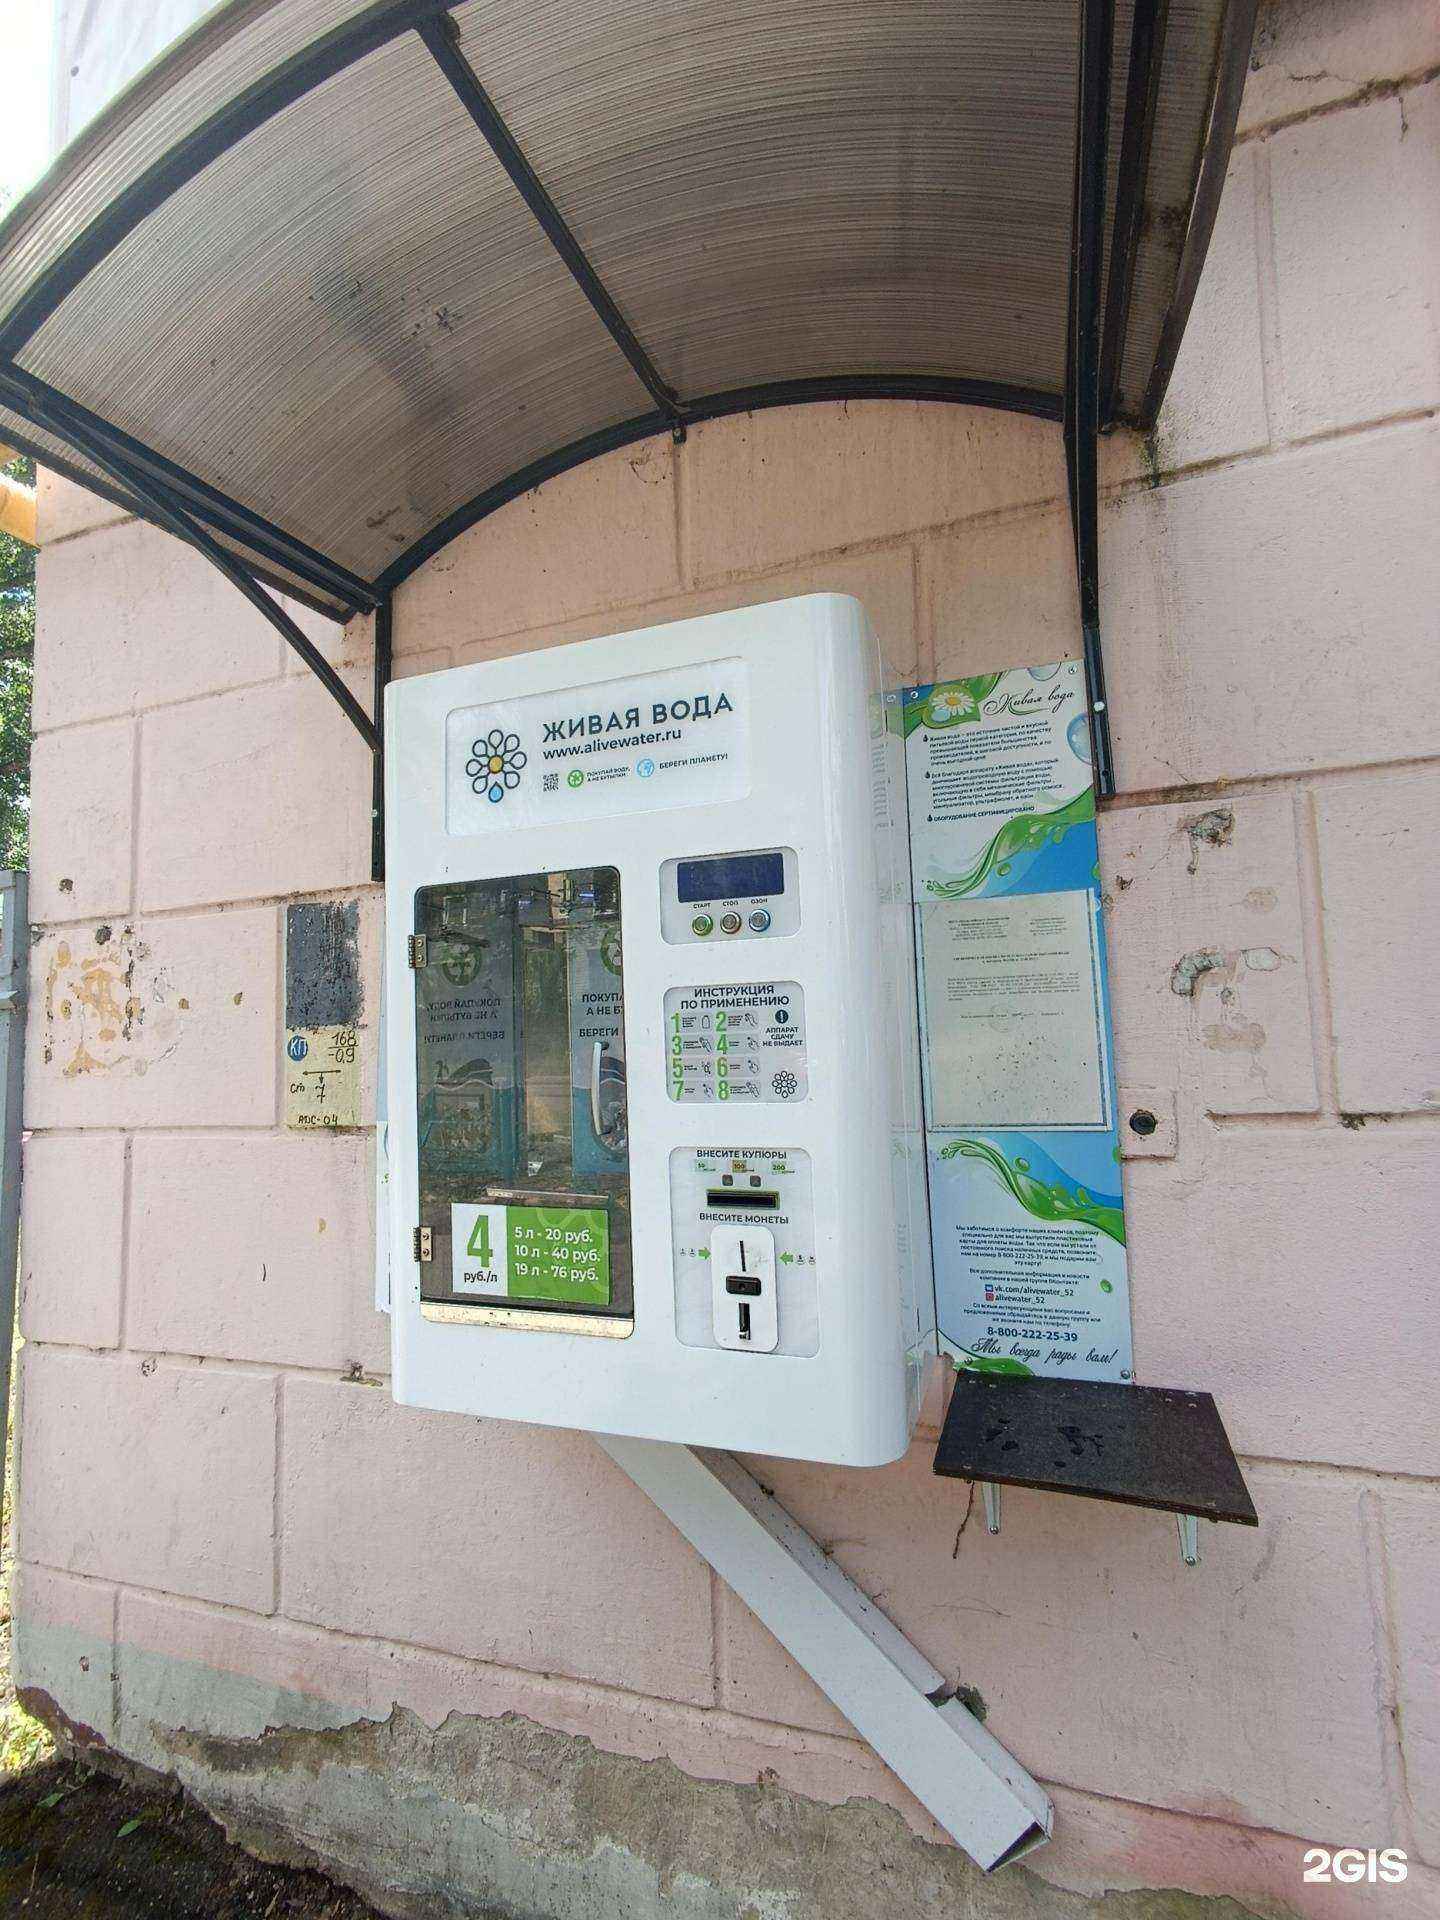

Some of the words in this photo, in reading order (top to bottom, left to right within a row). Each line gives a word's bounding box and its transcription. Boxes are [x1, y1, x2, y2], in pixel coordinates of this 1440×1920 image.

[983, 688, 1041, 715] Живая
[1047, 684, 1074, 713] вода
[543, 707, 640, 743] ЖИВАЯ
[652, 693, 733, 724] ВОДА
[543, 728, 681, 760] www.alivewater.ru
[660, 760, 688, 770] БЕРЕГИ
[690, 753, 728, 765] ПЛАНЕТУ!
[933, 812, 976, 822] ОБОРУДОВАНИЕ
[977, 806, 1035, 818] СЕРТИФИЦИРОВАНО
[694, 985, 774, 997] ИНСТРУКЦИЯ
[586, 1007, 594, 1015] А
[597, 1006, 610, 1015] НЕ
[681, 1000, 697, 1009] ПО
[701, 995, 789, 1009] ПРИМЕНЕНИЮ
[671, 1012, 680, 1033] 1
[716, 1011, 727, 1032] 2
[765, 1026, 799, 1034] АППАРАТ
[332, 1030, 357, 1047] 168
[579, 1027, 618, 1037] БЕРЕГИ
[672, 1035, 682, 1055] 3
[717, 1034, 727, 1054] 4
[672, 1057, 683, 1078] 5
[717, 1056, 728, 1077] 6
[673, 1080, 684, 1101] 7
[718, 1080, 729, 1100] 8
[696, 1149, 740, 1159] ВНЕСИТЕ
[742, 1150, 787, 1160] КУПЮРЫ
[699, 1212, 742, 1224] ВНЕСИТЕ
[745, 1215, 789, 1224] МОНЕТЫ
[467, 1214, 494, 1268] 4
[514, 1226, 523, 1238] 5
[525, 1229, 534, 1239] л
[545, 1228, 561, 1240] 20
[565, 1229, 593, 1243] руб.
[514, 1244, 528, 1256] 10
[530, 1248, 540, 1258] л
[551, 1247, 568, 1259] 40
[572, 1248, 600, 1262] руб.
[464, 1270, 498, 1283] руб./л
[514, 1262, 528, 1275] 19
[531, 1266, 540, 1276] л
[551, 1265, 567, 1277] 76
[570, 1267, 599, 1281] руб.
[993, 1284, 1074, 1297] vk.com/alivewater_52
[987, 1326, 1078, 1342] 8-800-222-25-39
[971, 1337, 1001, 1354] Мы
[1009, 1342, 1041, 1363] всегда
[1044, 1347, 1078, 1366] рады
[1085, 1348, 1119, 1364] вам!
